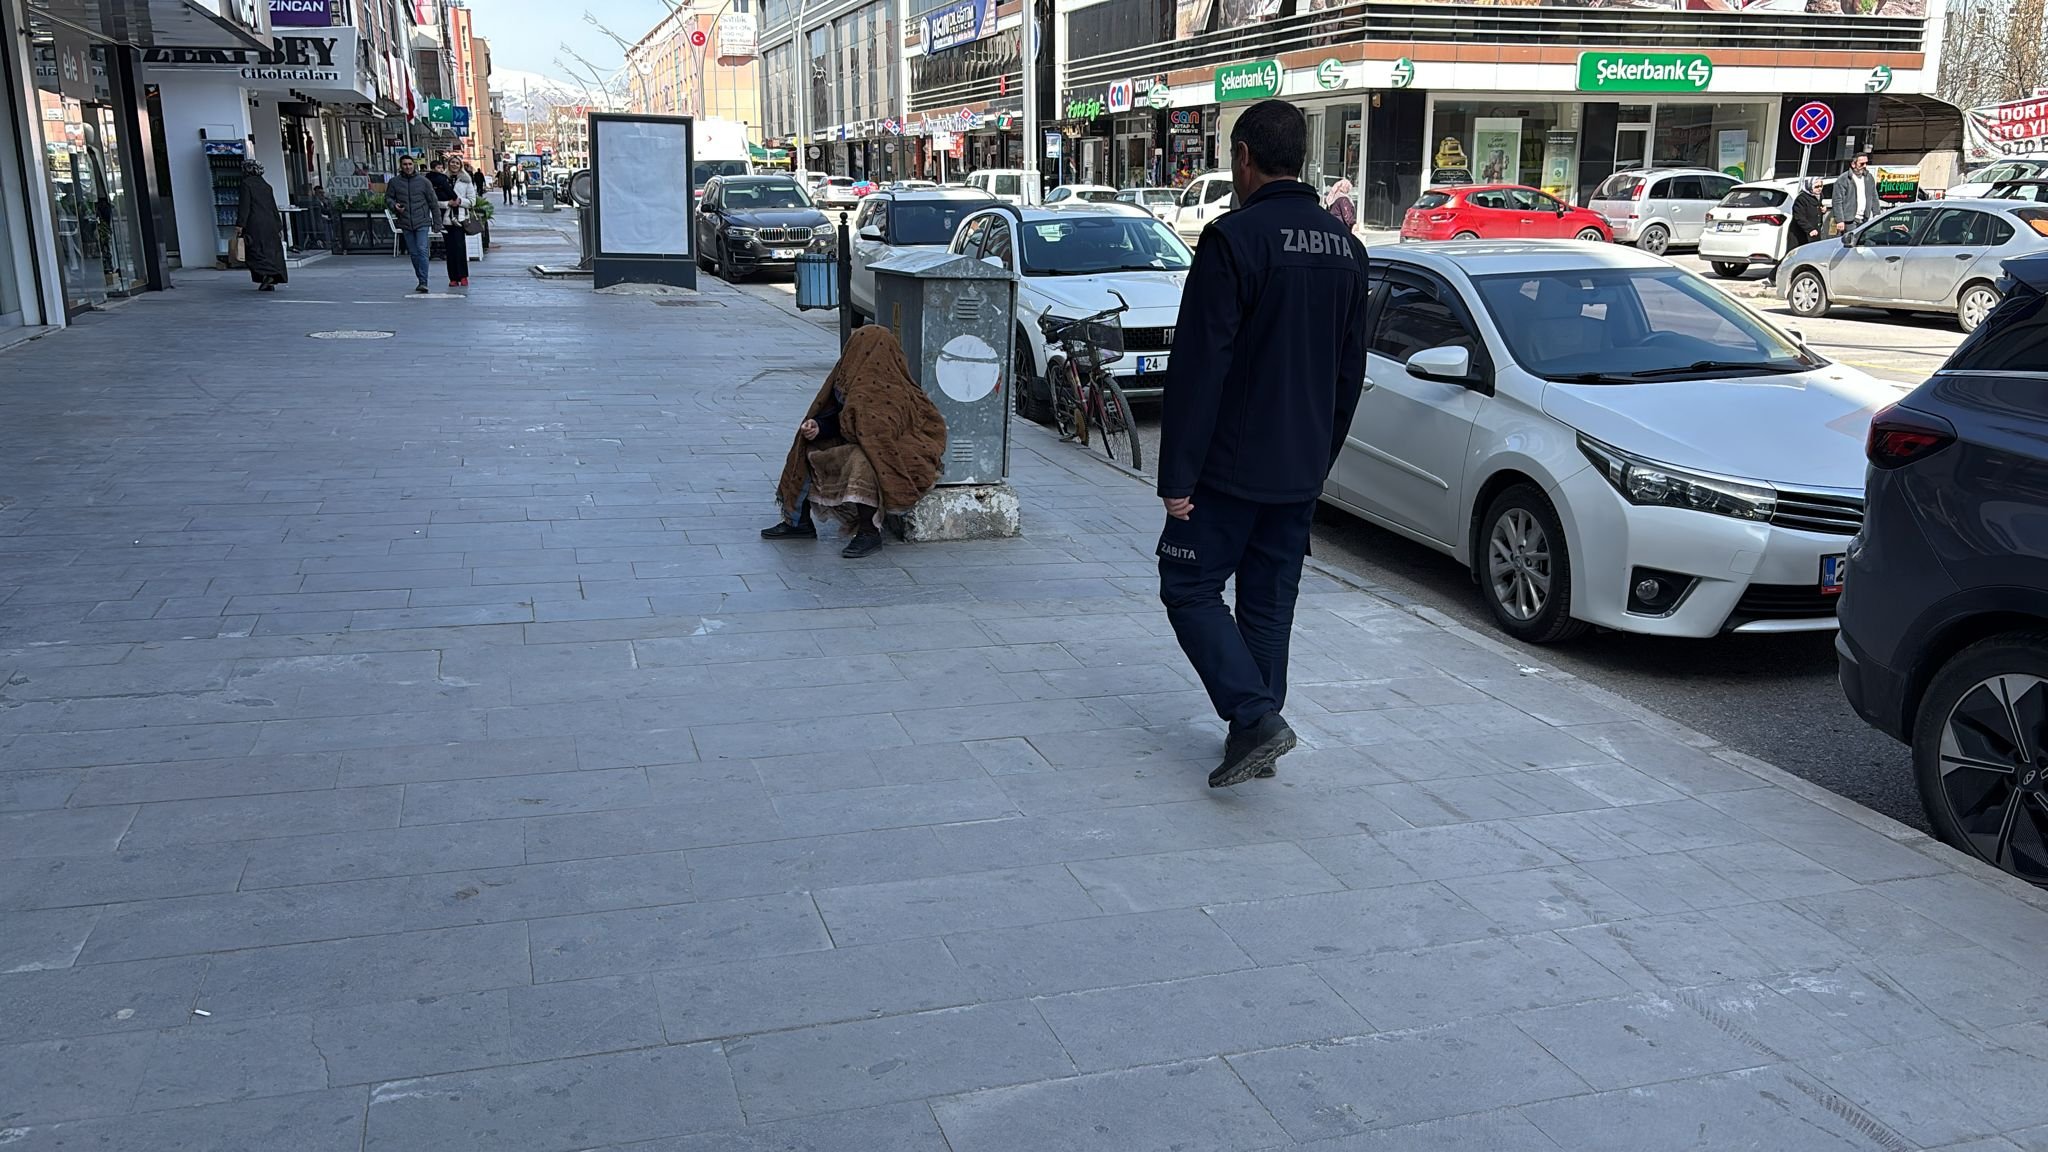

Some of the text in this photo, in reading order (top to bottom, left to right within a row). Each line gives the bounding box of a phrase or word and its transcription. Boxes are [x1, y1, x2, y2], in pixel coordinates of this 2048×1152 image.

[258, 37, 338, 66] BEY
[1221, 66, 1264, 96] Şekerbank
[1597, 58, 1686, 85] Şekerbank
[1170, 110, 1200, 124] can
[1879, 180, 1914, 194] Hacegan
[1280, 229, 1354, 260] ZABITA
[1145, 358, 1158, 370] 24
[1161, 542, 1197, 560] ZABITA
